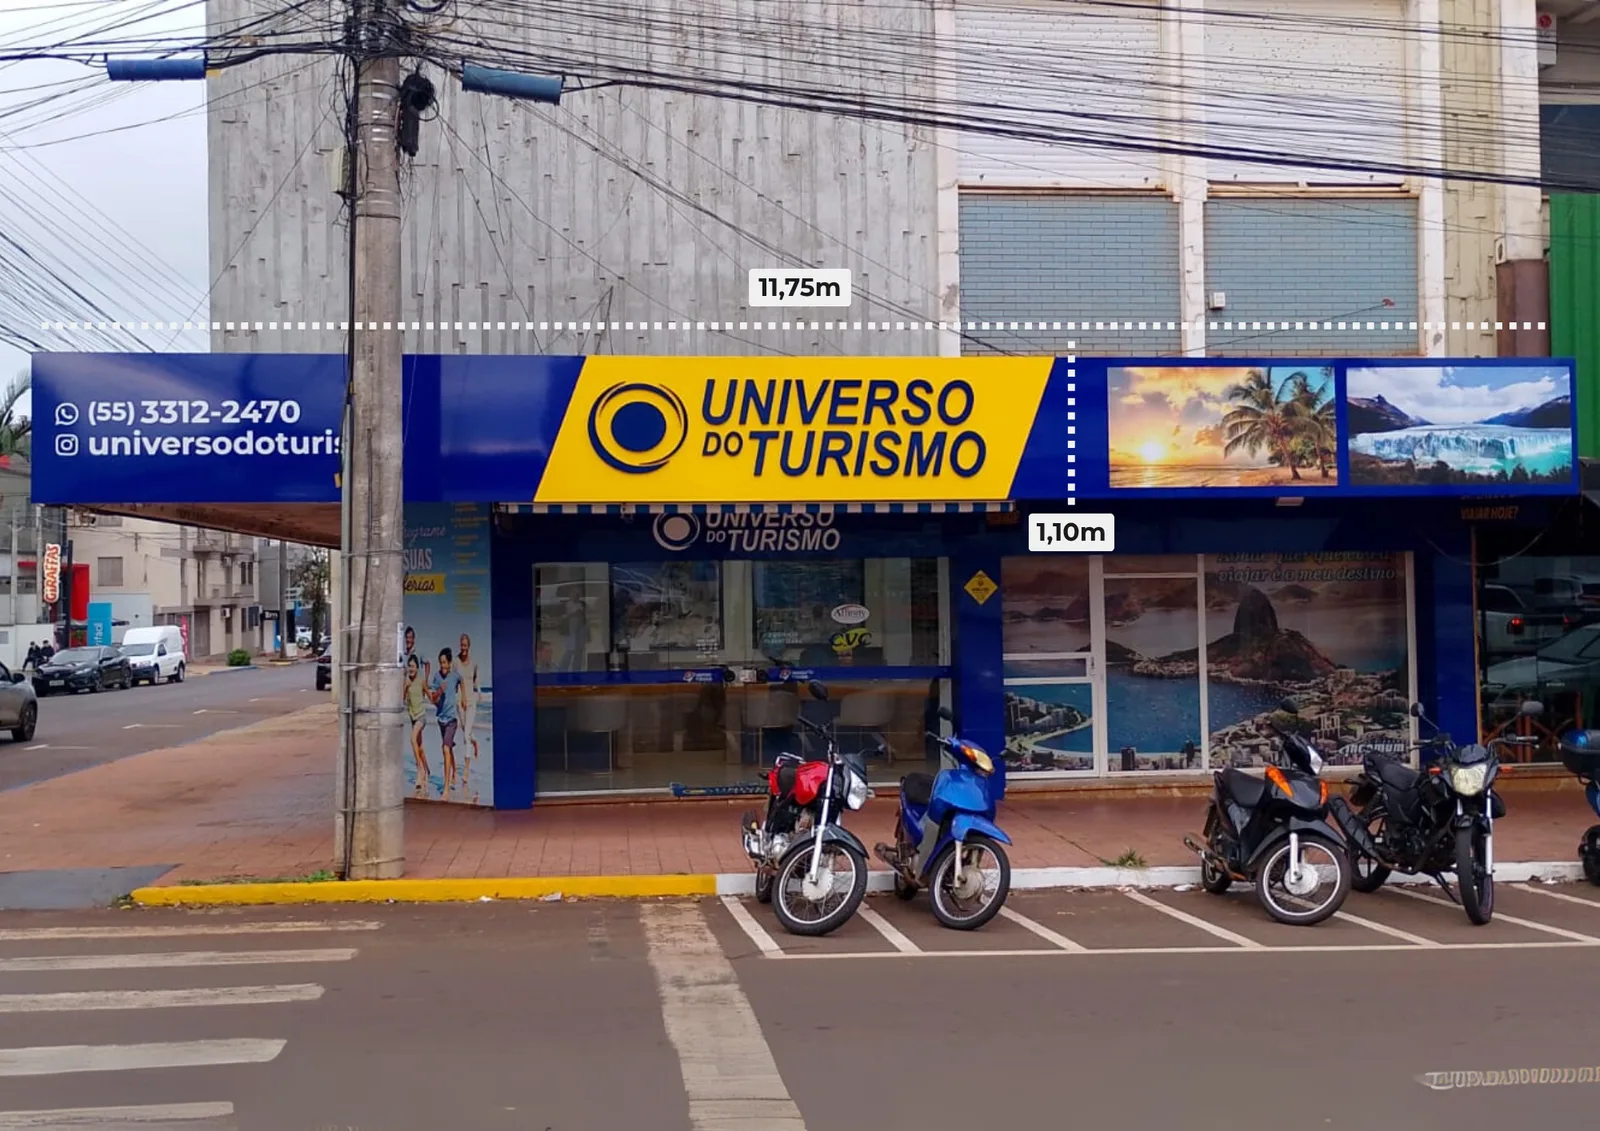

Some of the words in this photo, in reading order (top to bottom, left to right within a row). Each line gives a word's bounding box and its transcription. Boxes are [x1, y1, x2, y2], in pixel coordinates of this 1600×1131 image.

[88, 401, 135, 426] (55)
[140, 399, 301, 425] 3312-2470
[701, 378, 974, 426] UNIVERSO
[702, 431, 743, 458] DO
[748, 430, 987, 478] TURISMO
[704, 512, 835, 528] UNIVERSO
[706, 530, 726, 543] DO
[728, 528, 841, 552] TURISMO
[402, 548, 432, 570] SUAS
